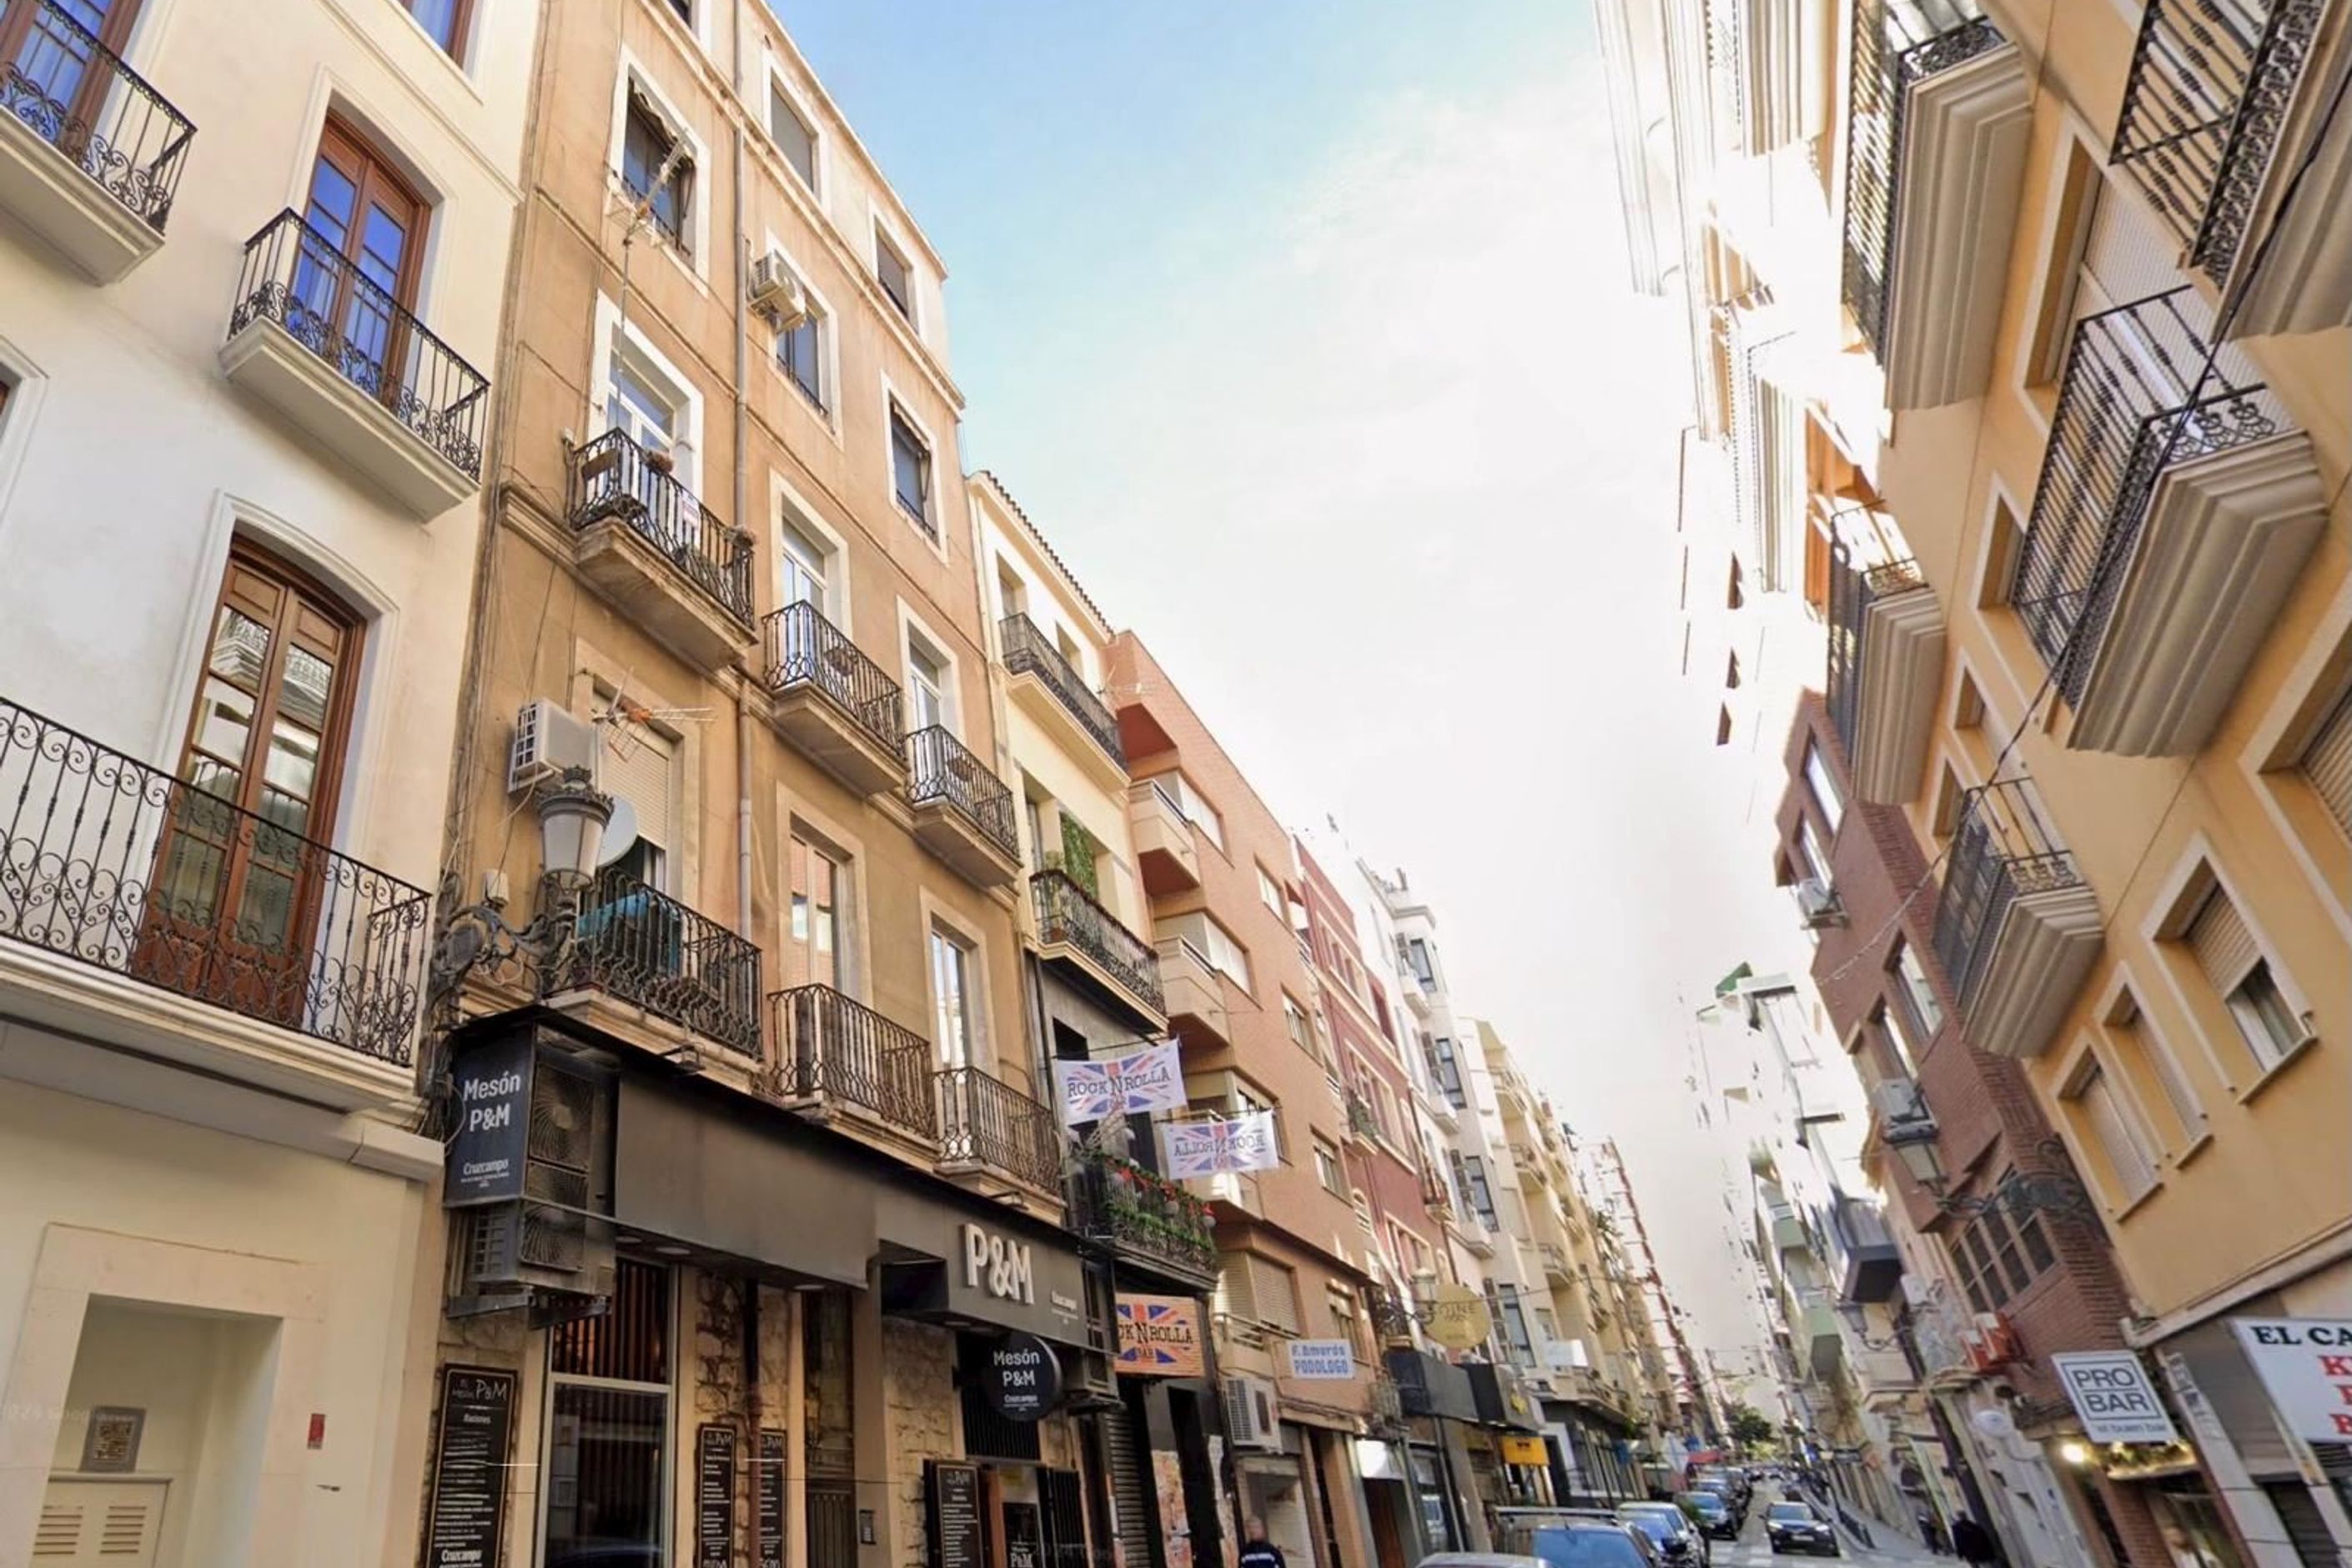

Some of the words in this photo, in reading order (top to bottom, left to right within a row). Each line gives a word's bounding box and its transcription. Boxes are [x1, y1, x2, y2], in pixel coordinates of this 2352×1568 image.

[463, 1071, 521, 1102] Mesón
[1067, 1080, 1108, 1098] ROCK
[1123, 1066, 1171, 1092] ROLLA
[469, 1103, 511, 1133] P&M
[966, 1223, 1035, 1304] P&M
[1149, 1325, 1193, 1344] ROLLA
[2250, 1325, 2303, 1344] EL
[993, 1348, 1040, 1365] Mesón
[1294, 1359, 1349, 1375] PODOLOGO
[1003, 1369, 1036, 1387] P&M
[2073, 1368, 2136, 1388] PRO
[2085, 1394, 2149, 1413] BAR
